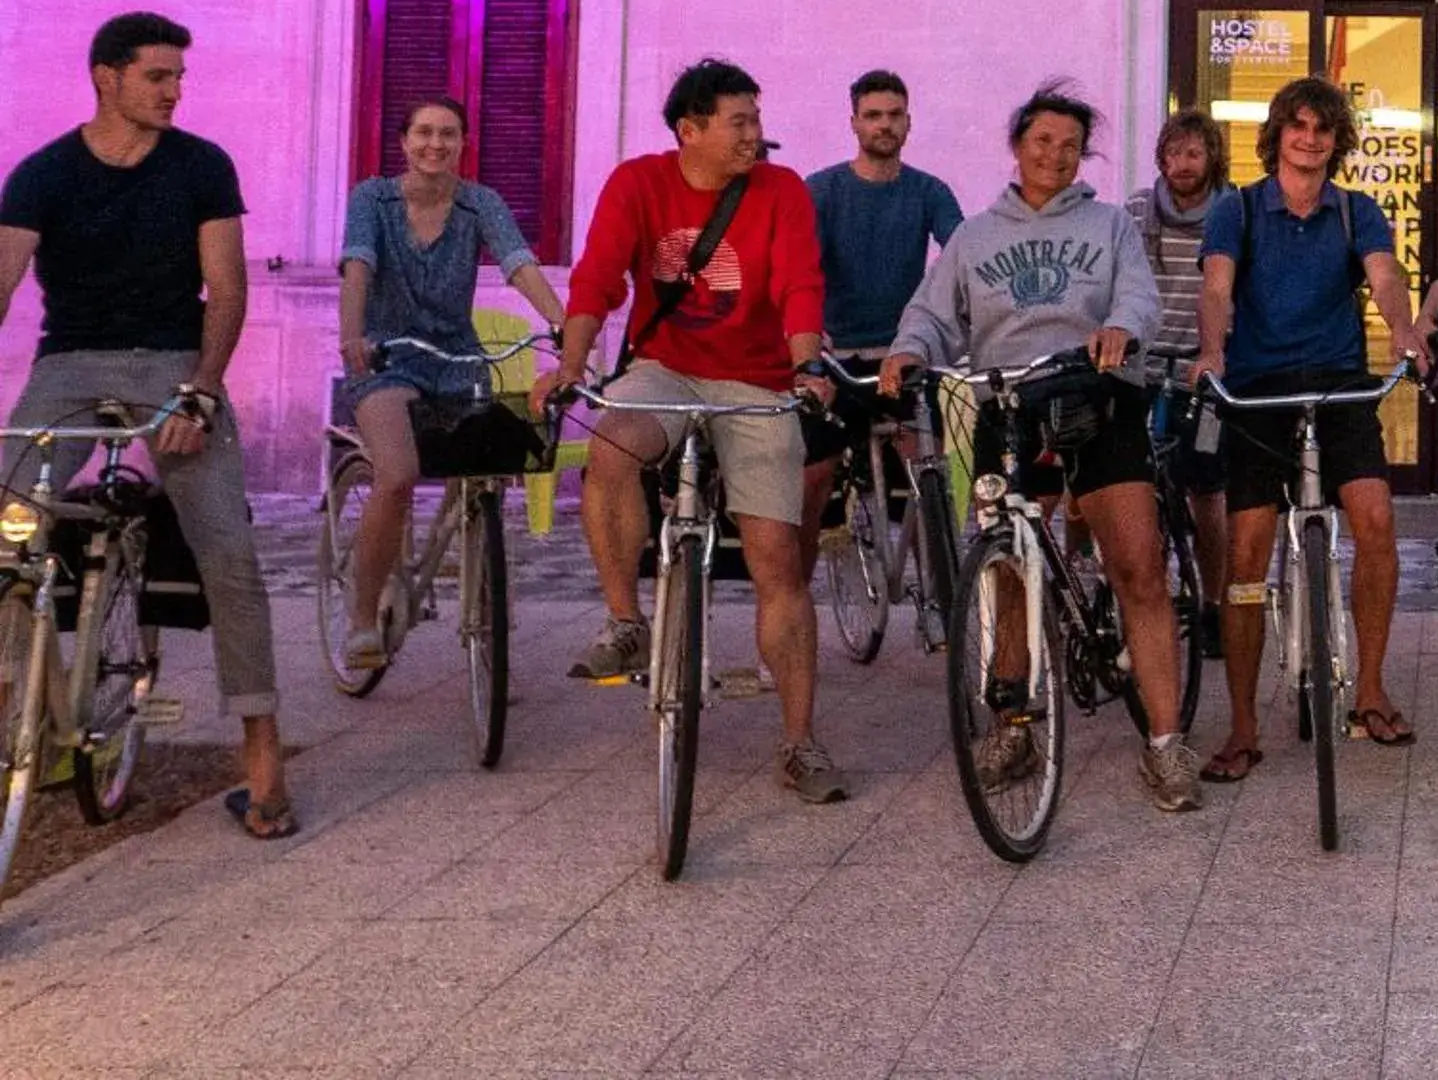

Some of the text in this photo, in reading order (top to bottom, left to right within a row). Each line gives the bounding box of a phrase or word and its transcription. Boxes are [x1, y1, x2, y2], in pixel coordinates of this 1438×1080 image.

[1211, 20, 1291, 38] HOSTEL
[1210, 37, 1291, 55] &SPACE
[974, 236, 1104, 289] MONTREAL
